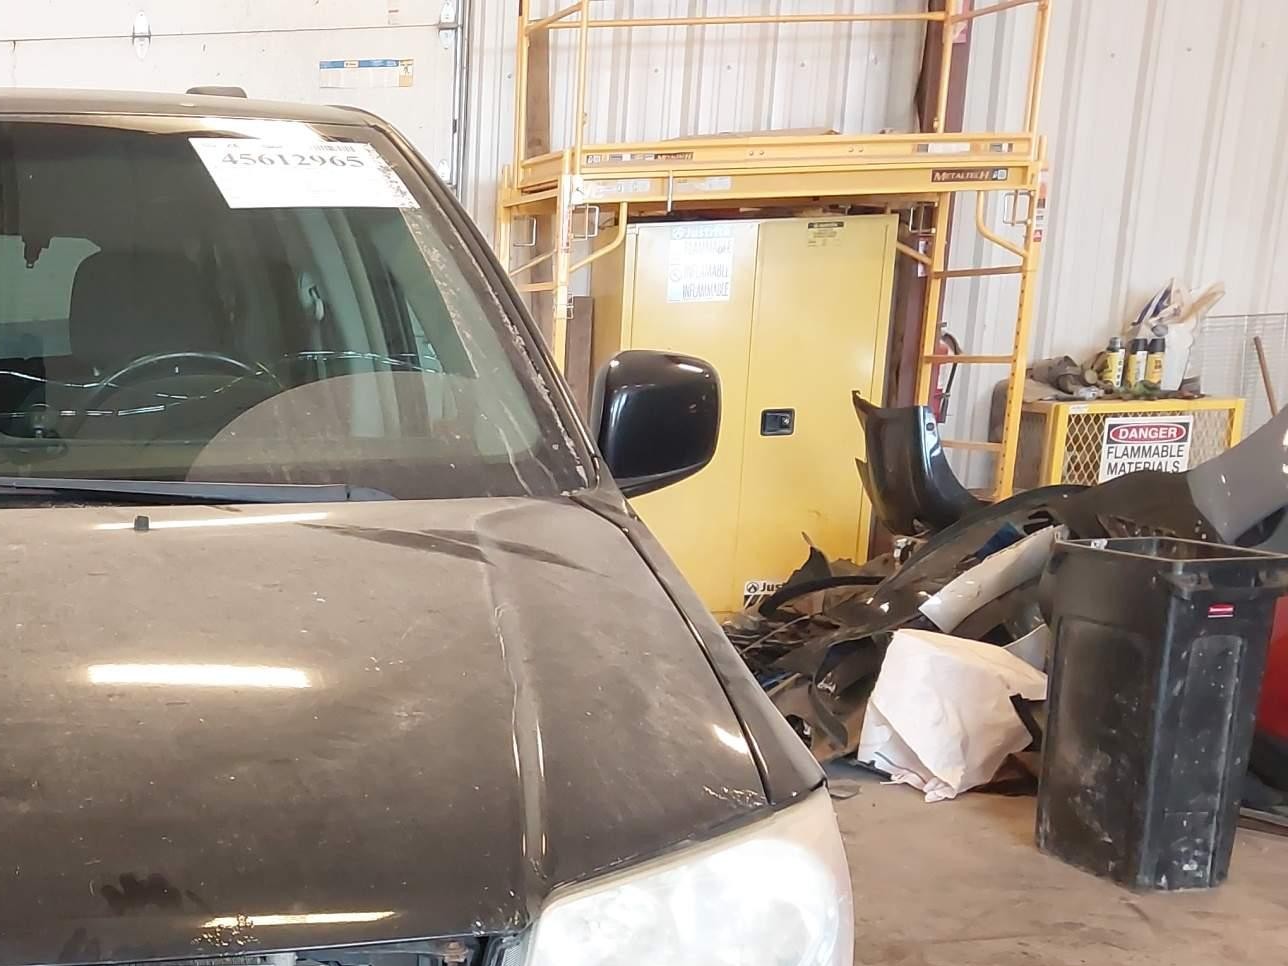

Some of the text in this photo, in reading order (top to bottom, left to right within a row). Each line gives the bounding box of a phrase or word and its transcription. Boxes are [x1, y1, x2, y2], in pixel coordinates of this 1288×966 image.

[222, 152, 365, 168] 45612965
[1118, 427, 1178, 440] DANGER
[1107, 444, 1185, 460] FLAMMABLE
[1107, 460, 1181, 476] MATERIALS
